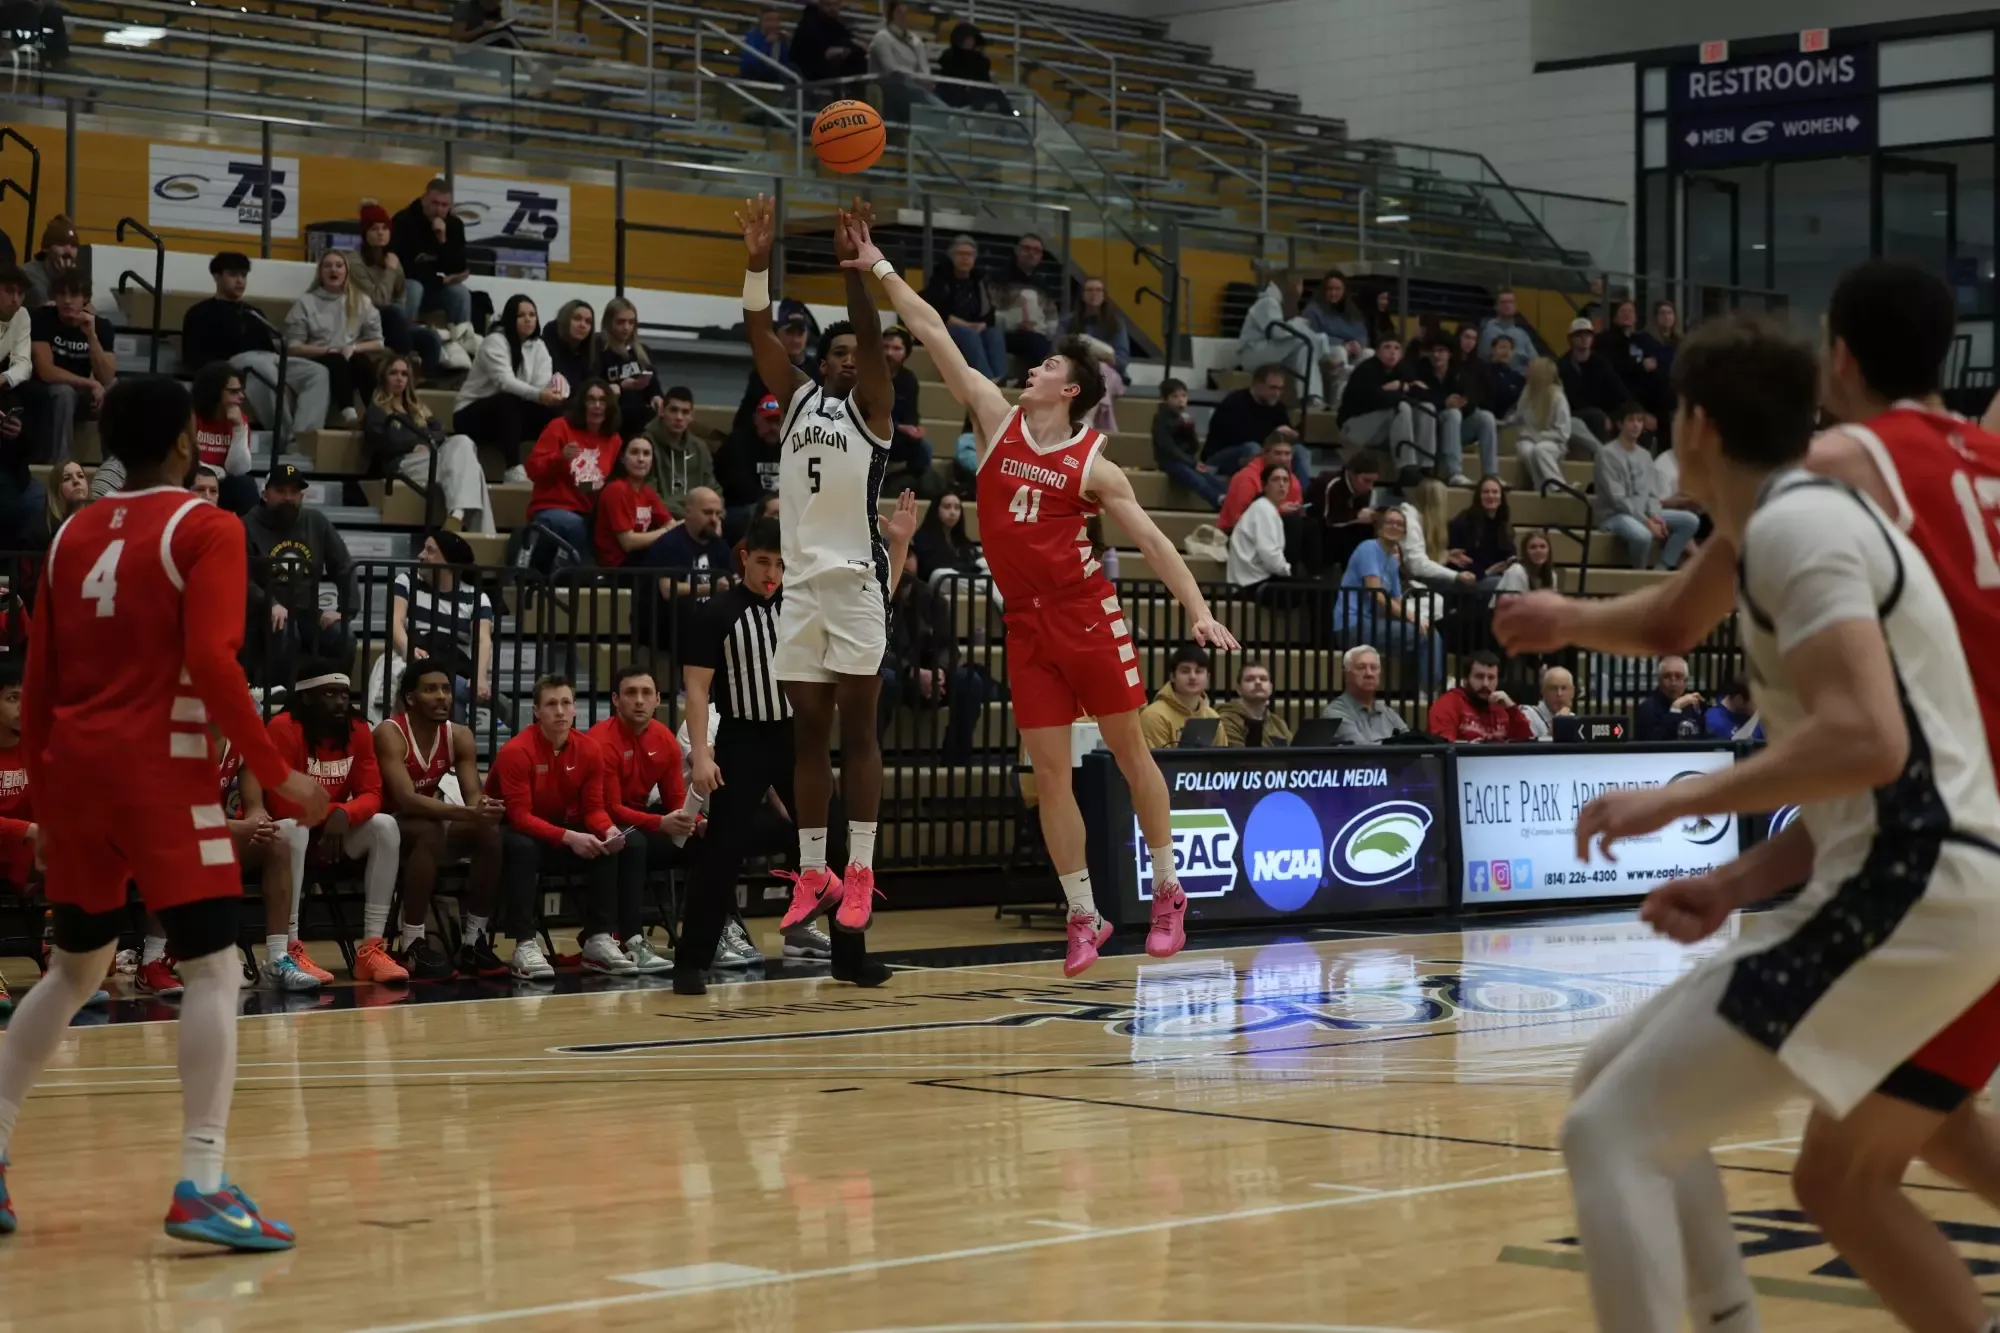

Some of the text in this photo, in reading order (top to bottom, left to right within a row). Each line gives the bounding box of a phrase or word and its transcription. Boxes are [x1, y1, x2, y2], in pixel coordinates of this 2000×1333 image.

[1688, 54, 1856, 100] RESTROOMS
[819, 113, 869, 134] Wilson
[1702, 116, 1845, 146] MEN WOMEN
[222, 161, 287, 221] 75
[238, 207, 263, 219] PSA
[502, 190, 559, 242] 75
[791, 425, 848, 453] CLARION
[286, 465, 295, 476] P
[808, 457, 821, 494] 5
[1000, 457, 1068, 490] EDINBORO
[1008, 484, 1043, 523] 41
[81, 538, 126, 618] 4
[1174, 768, 1388, 792] FOLLOW US ON SOCIAL MEDIA
[1253, 848, 1322, 882] NCAA
[1544, 862, 1719, 886] (814) 226-4300 www.eagle-park
